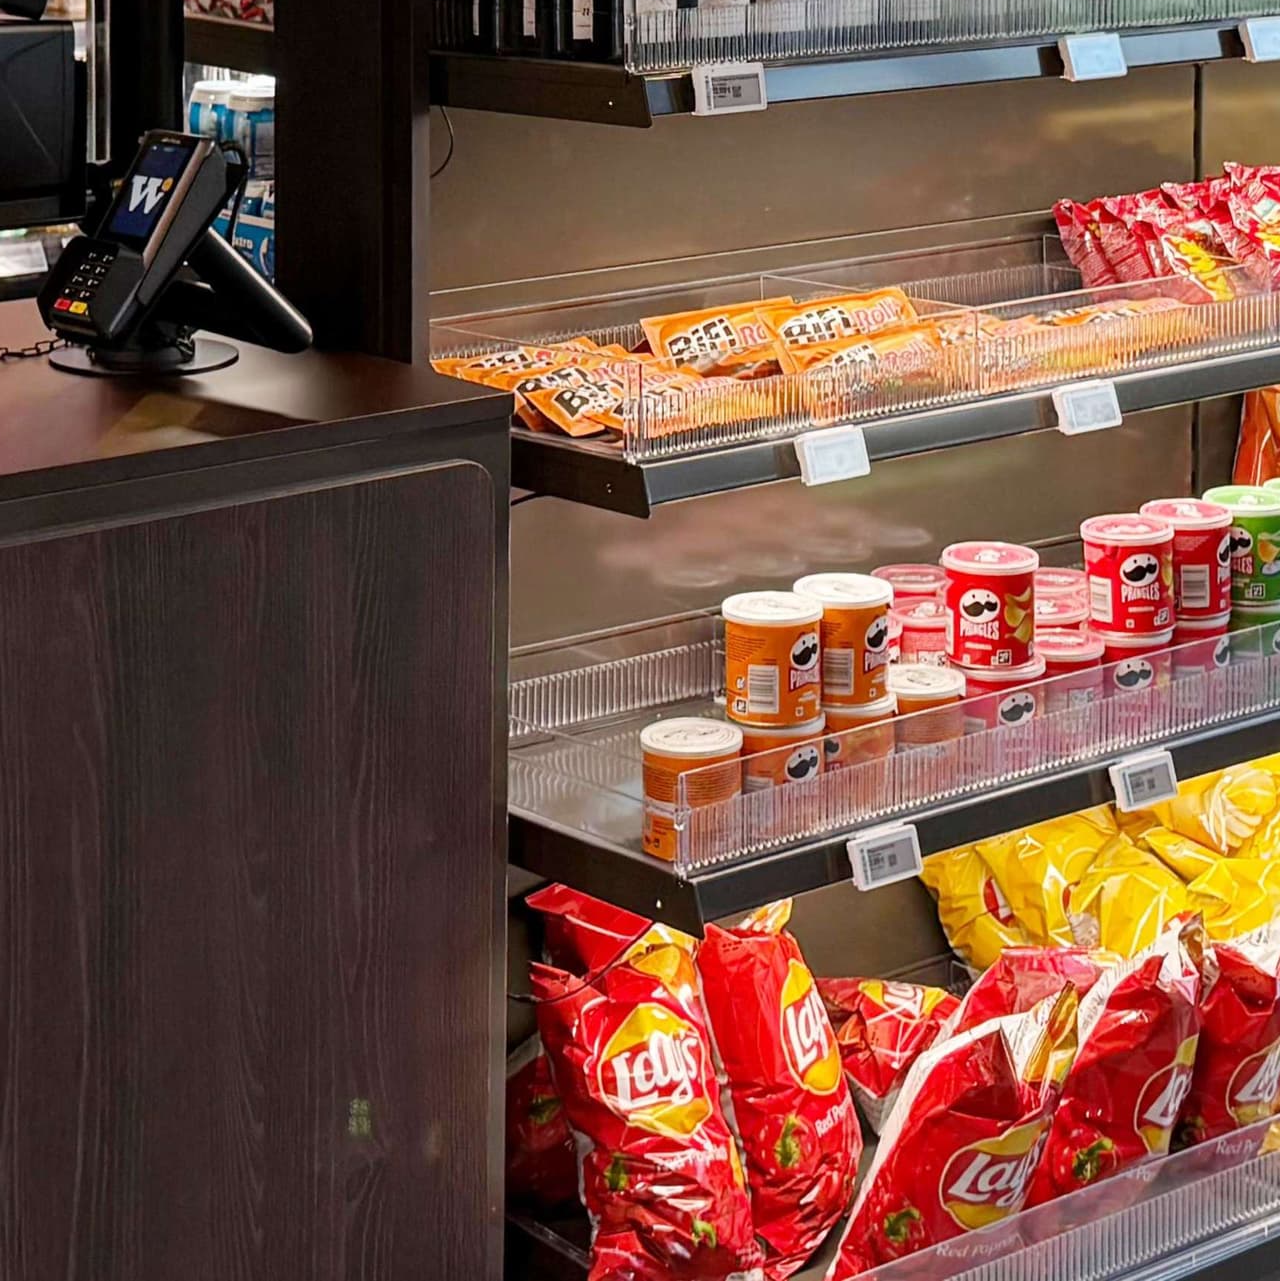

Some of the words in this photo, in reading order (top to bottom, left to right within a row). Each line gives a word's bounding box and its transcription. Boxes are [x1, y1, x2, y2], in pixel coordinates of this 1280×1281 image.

[128, 174, 166, 215] W
[1121, 582, 1160, 603] PRINGLES
[959, 620, 1000, 641] PRINGLES
[612, 1029, 699, 1110] Lay's
[935, 1239, 968, 1258] Red
